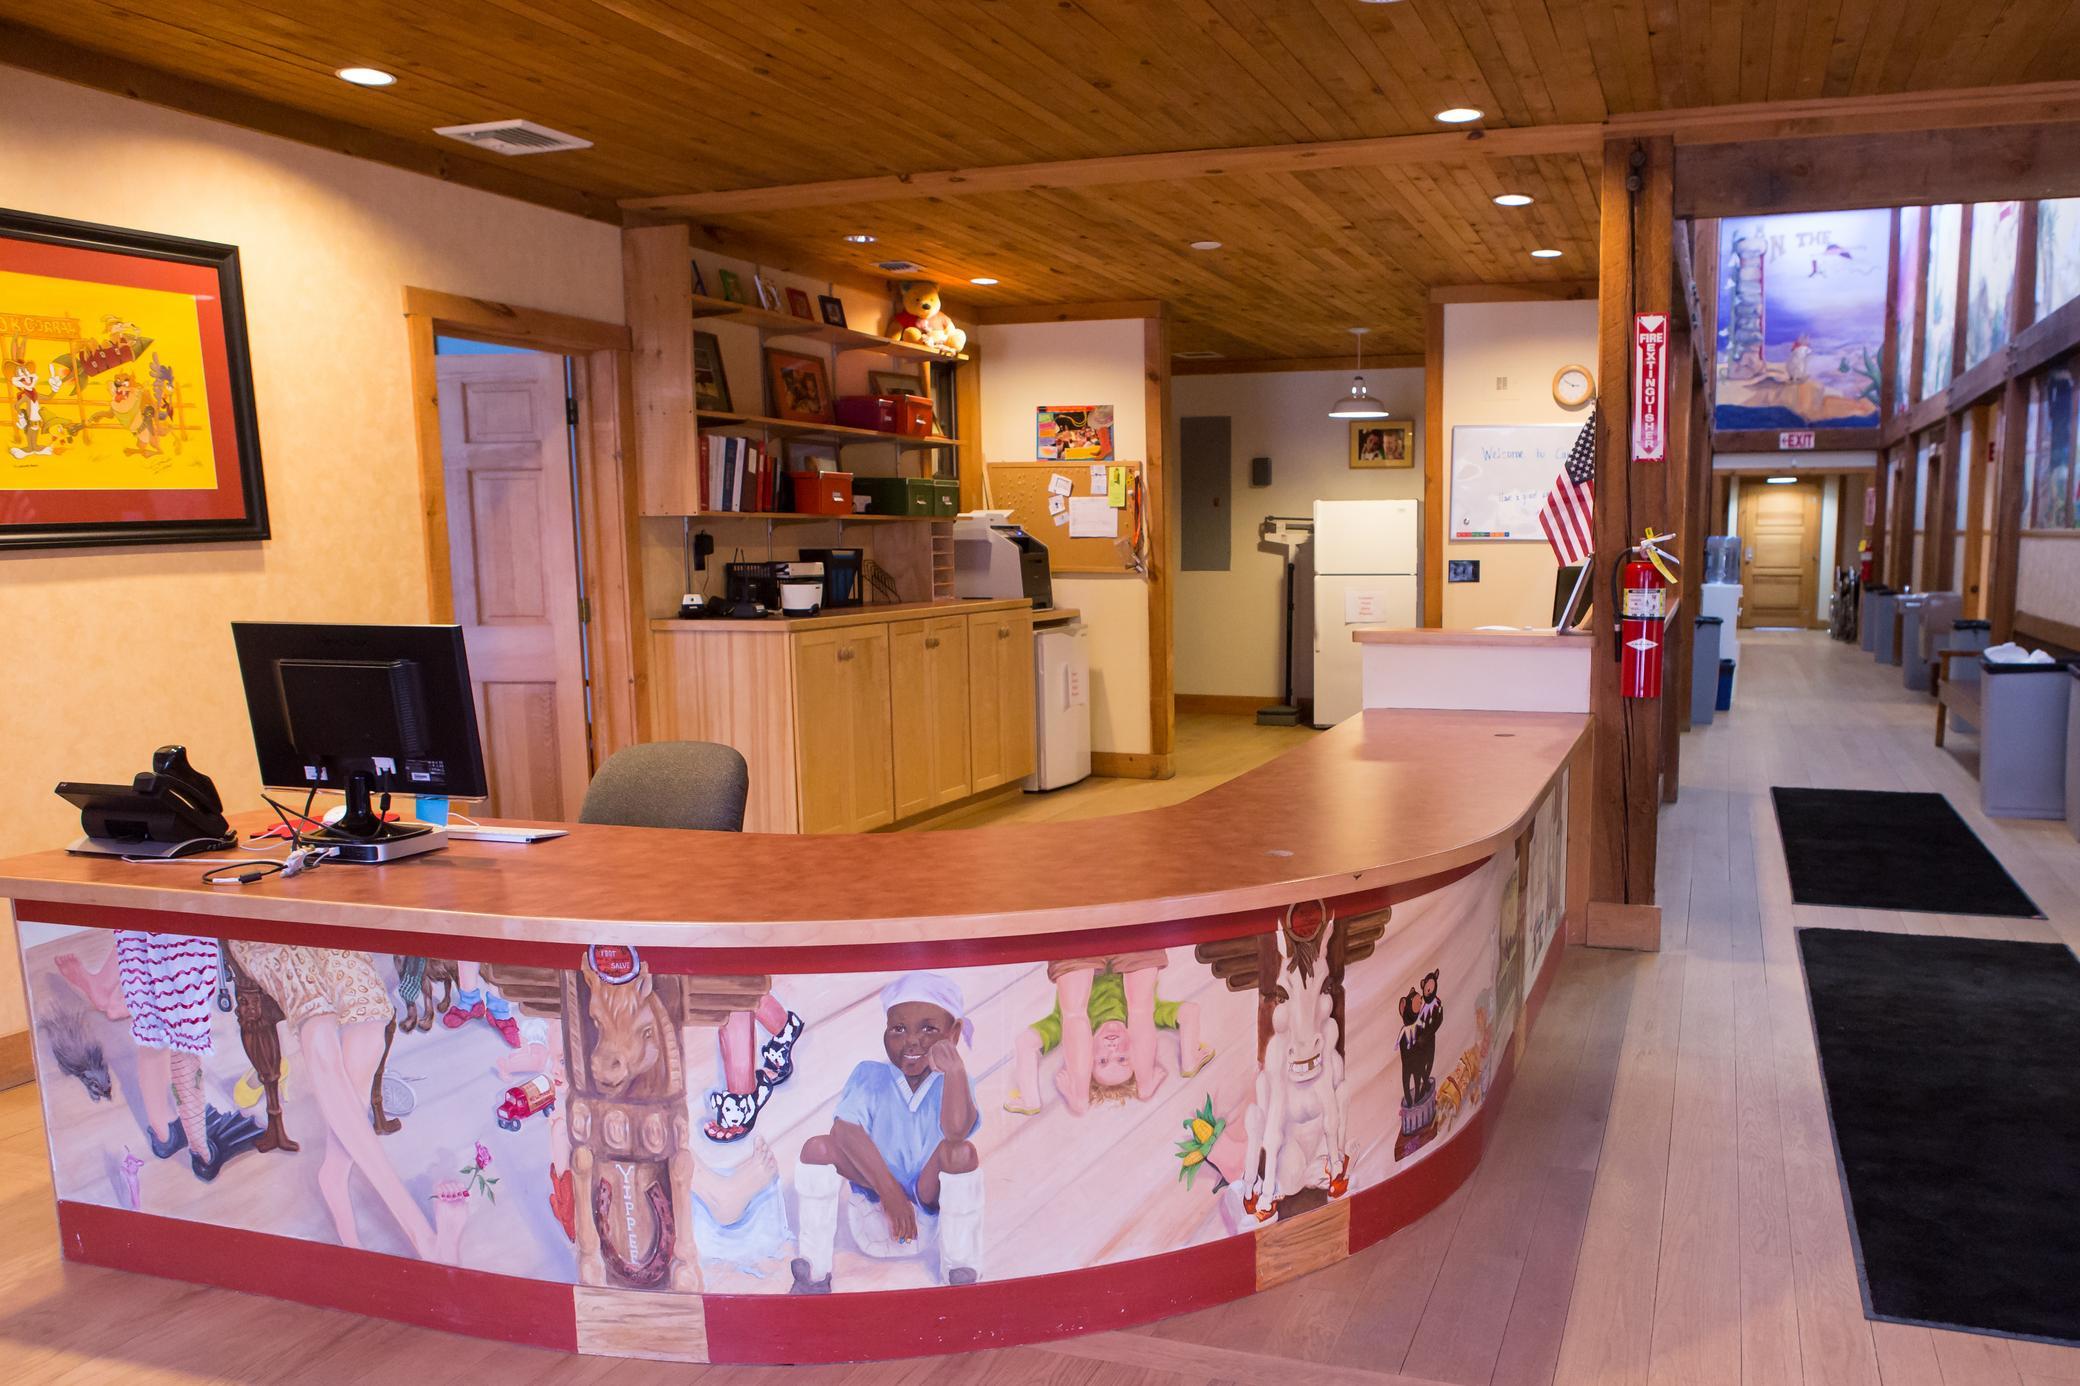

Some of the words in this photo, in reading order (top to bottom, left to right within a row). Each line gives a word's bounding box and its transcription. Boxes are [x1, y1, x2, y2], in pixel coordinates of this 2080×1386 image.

[1640, 333, 1663, 343] FIRE
[1645, 344, 1656, 447] EXTINGUISHER
[1788, 434, 1812, 448] EXIT
[1482, 447, 1524, 460] Welcome
[610, 961, 630, 970] SALVE
[615, 1164, 639, 1265] YIPPEE
